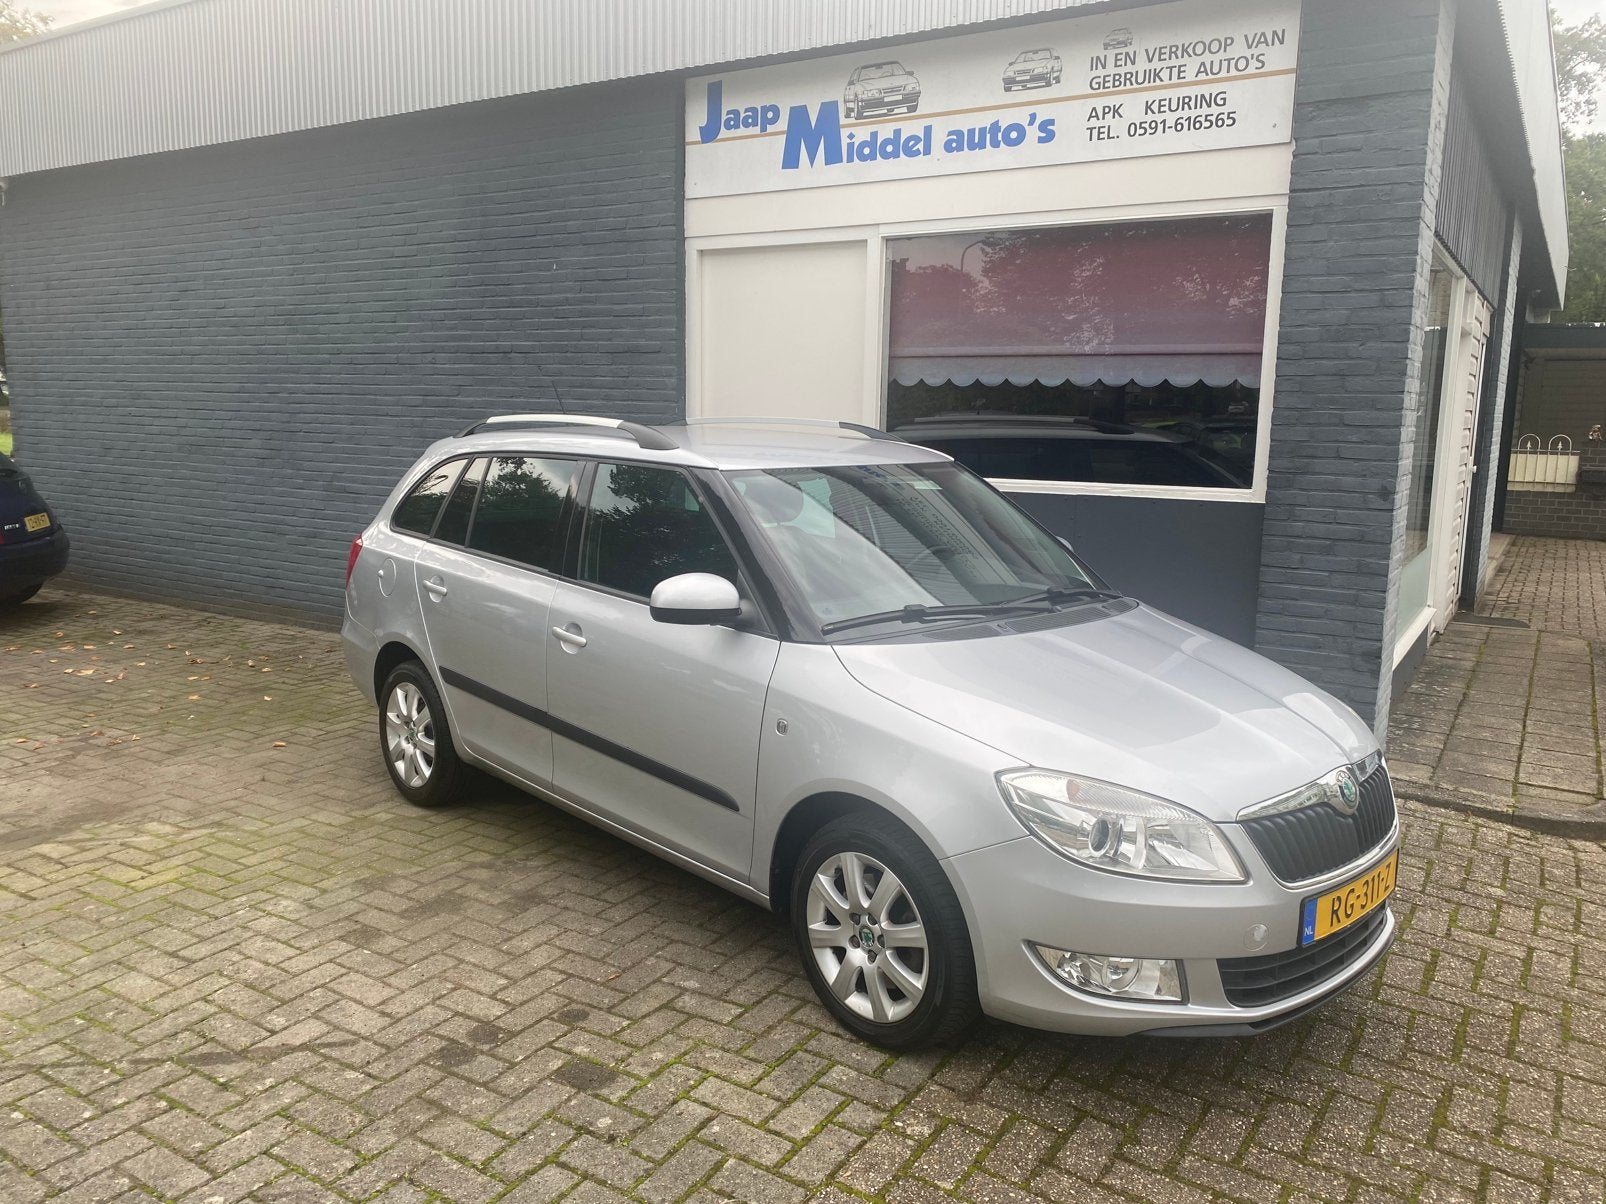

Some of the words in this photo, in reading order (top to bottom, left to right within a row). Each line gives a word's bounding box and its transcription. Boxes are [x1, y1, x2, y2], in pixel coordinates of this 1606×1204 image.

[1089, 56, 1107, 72] IN
[1113, 50, 1137, 68] EN
[1144, 36, 1235, 64] VERKOOP
[1244, 28, 1287, 49] VAN
[1089, 64, 1187, 91] GEBRUIKTE
[1195, 53, 1266, 78] AUTO'S
[699, 80, 781, 144] Jaap
[1086, 125, 1120, 142] TEL.
[1127, 111, 1237, 138] 0591-616565
[1087, 103, 1124, 122] APK
[1144, 91, 1228, 116] KEURING
[781, 100, 932, 169] Middel
[943, 112, 1056, 154] auto's
[1330, 861, 1392, 927] RG-311-Z
[1304, 926, 1314, 936] NL
